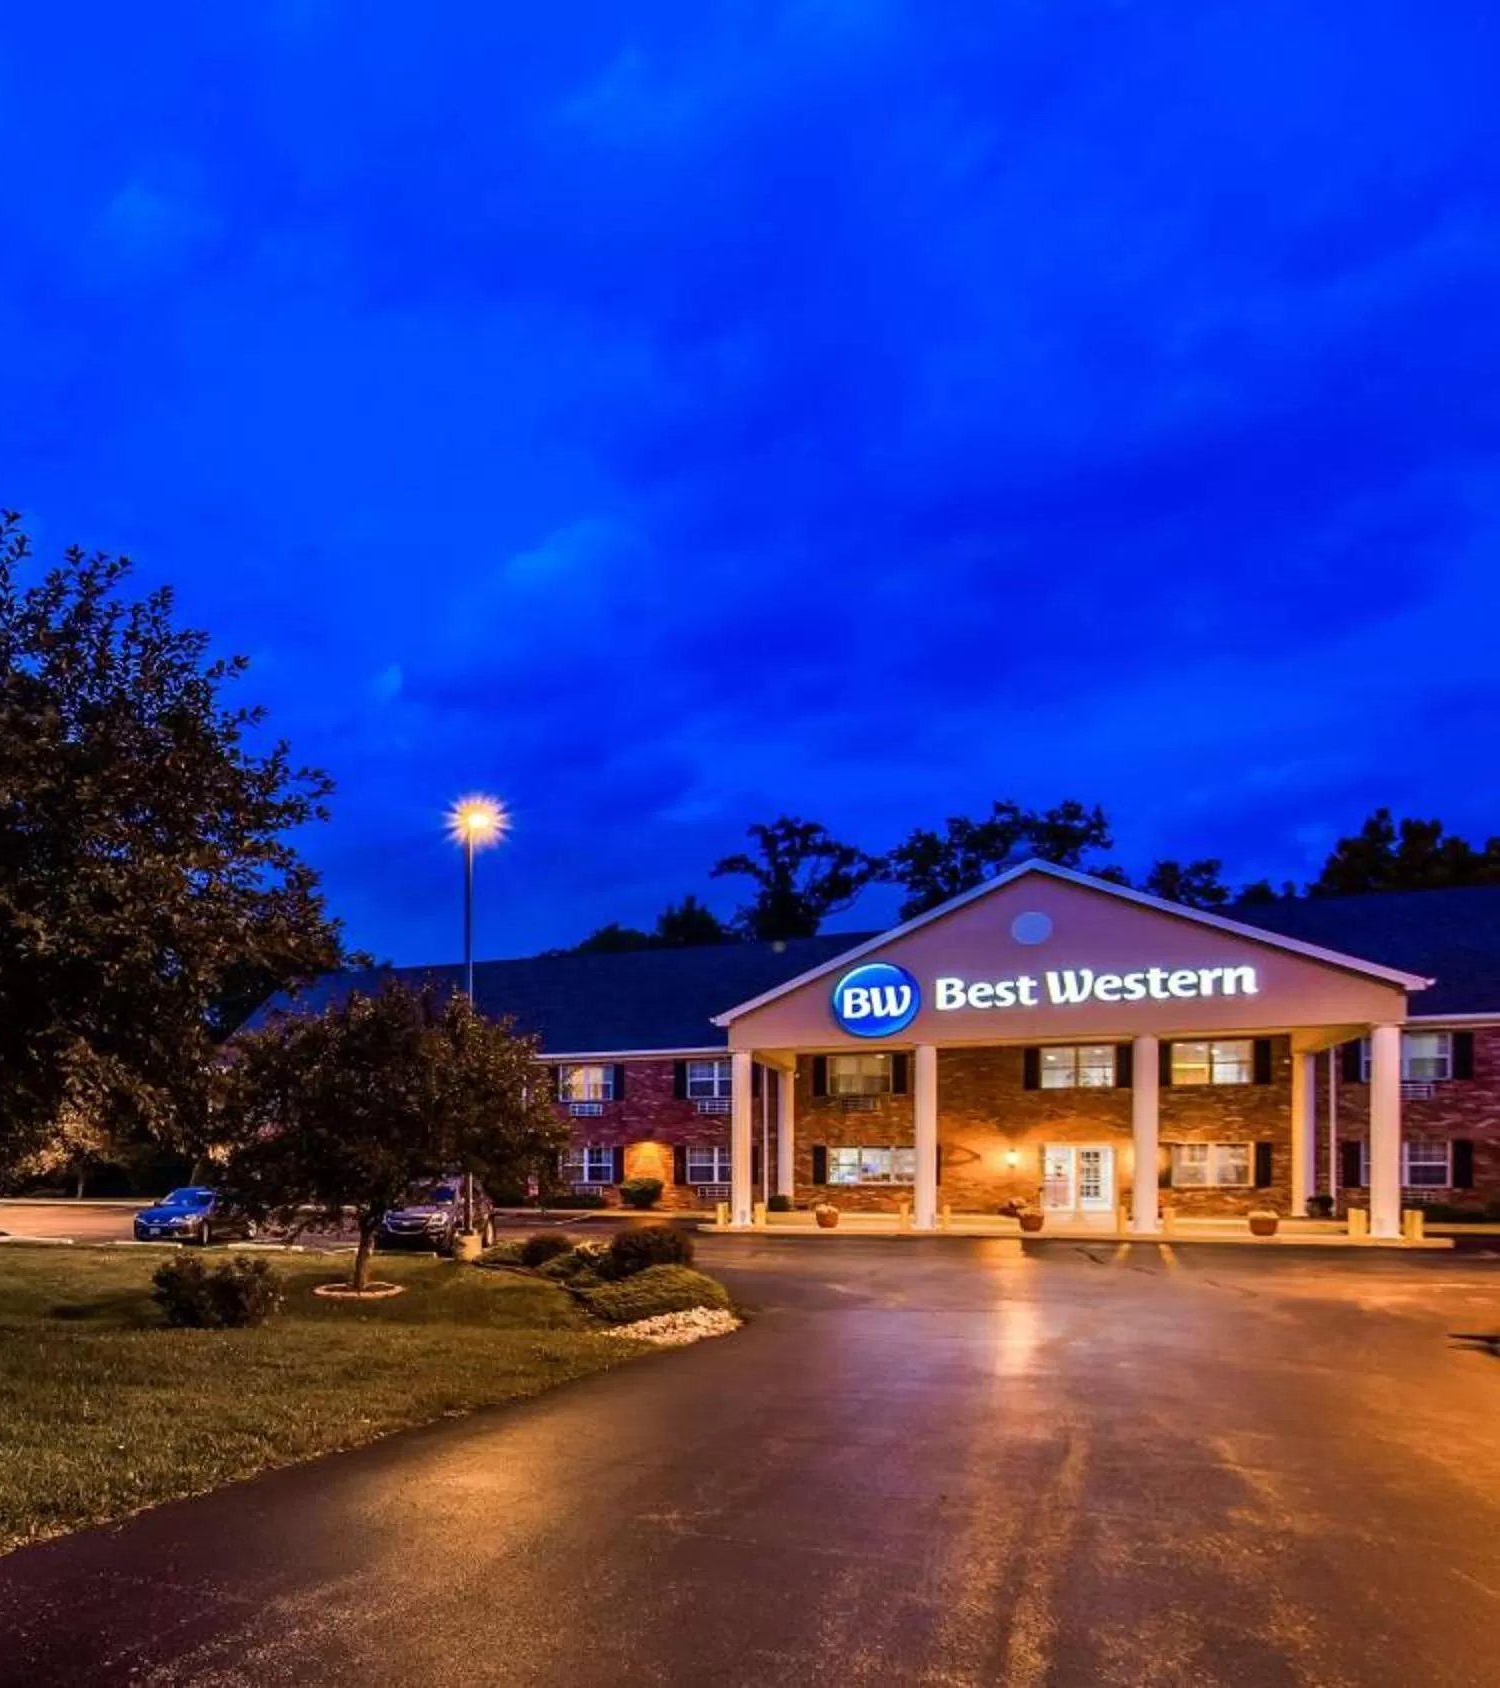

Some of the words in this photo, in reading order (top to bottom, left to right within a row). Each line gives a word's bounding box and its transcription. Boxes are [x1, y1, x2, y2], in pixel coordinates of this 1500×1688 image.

[841, 984, 912, 1019] BW
[935, 976, 1038, 1010] Best
[1046, 966, 1260, 1004] Western
